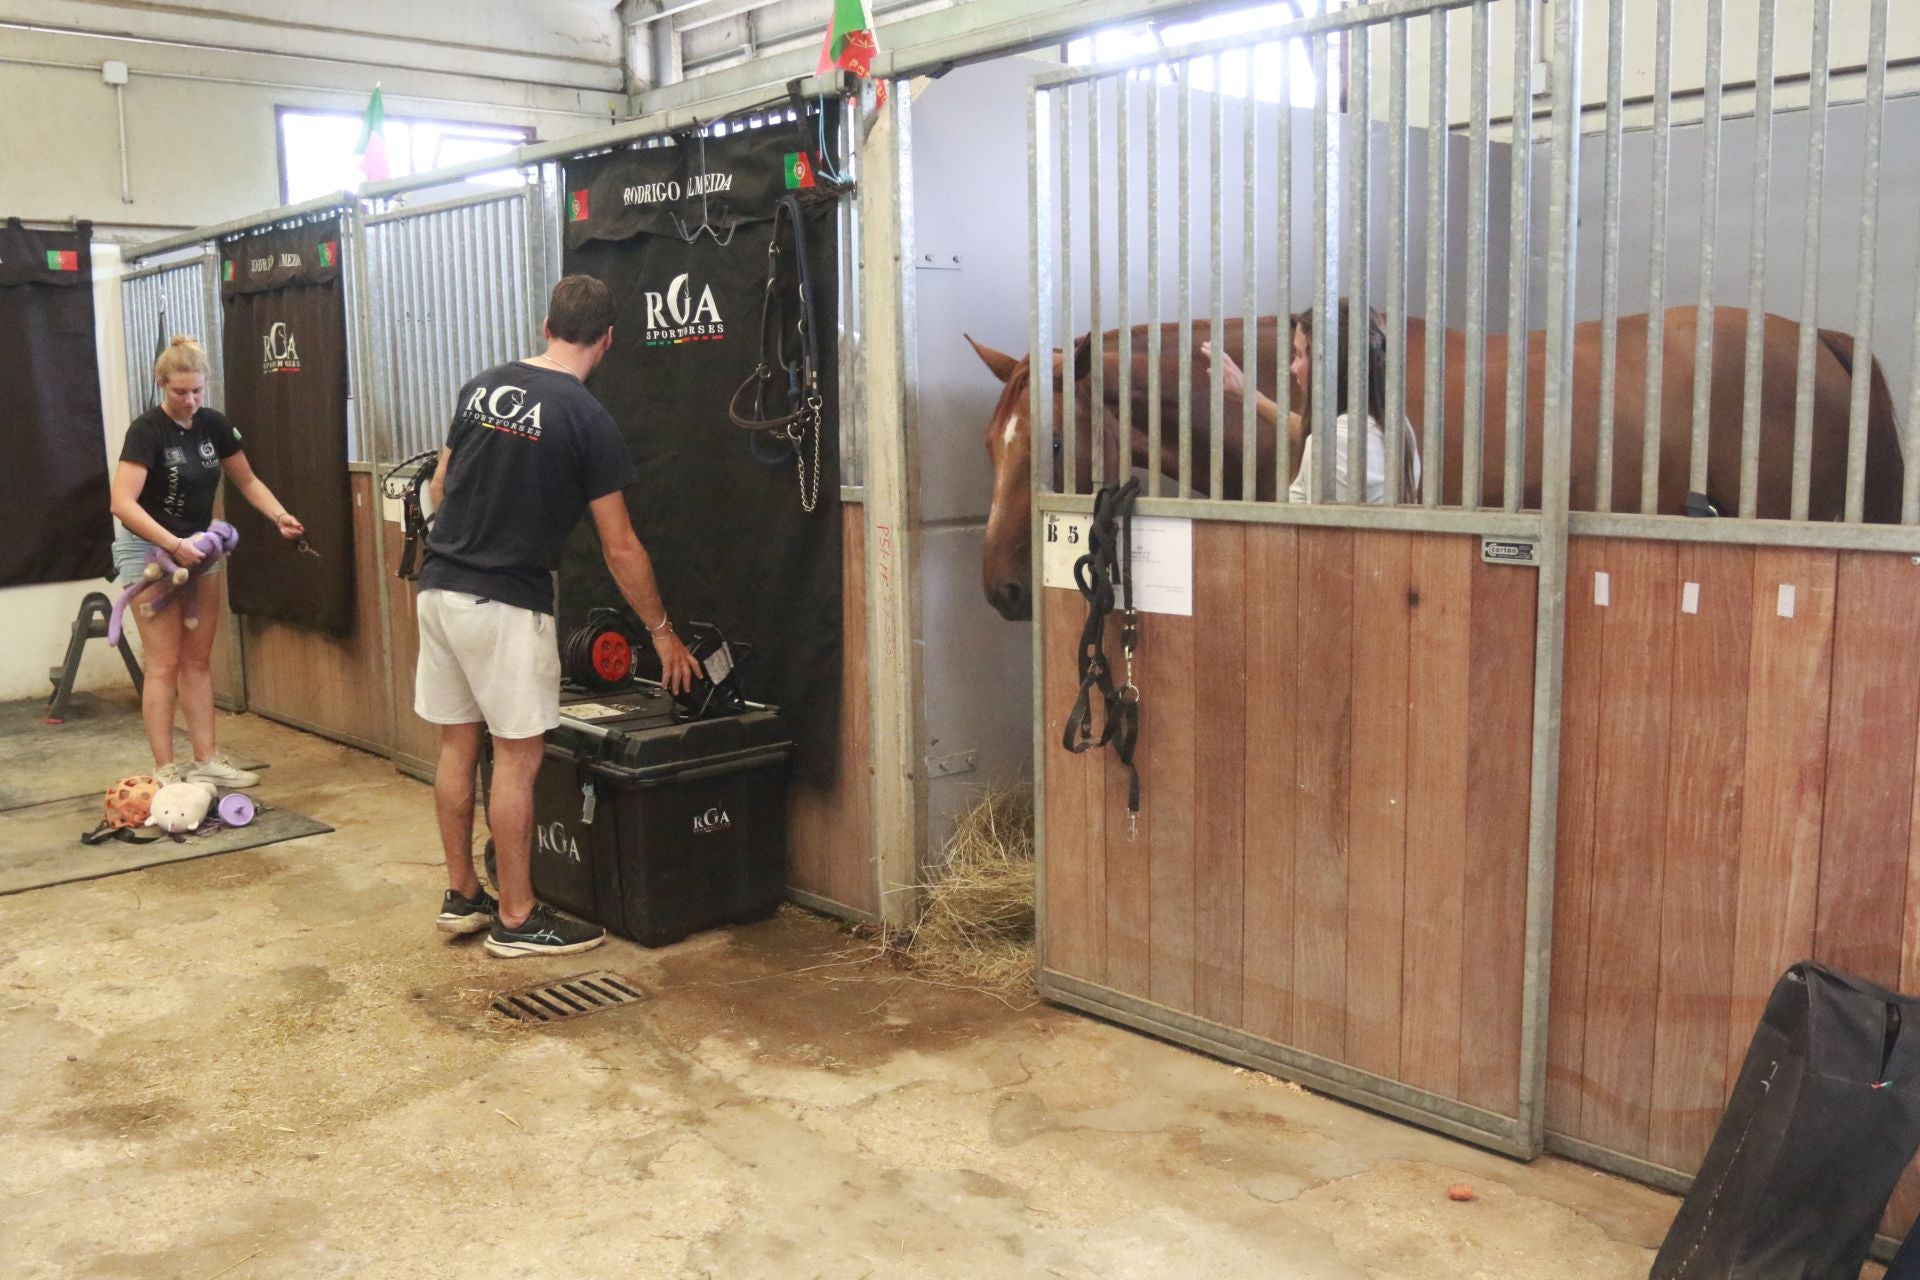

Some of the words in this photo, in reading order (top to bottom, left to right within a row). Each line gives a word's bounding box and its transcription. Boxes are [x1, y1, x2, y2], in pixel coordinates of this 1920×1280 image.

[624, 182, 681, 206] RODRIGO
[644, 272, 723, 330] RGA
[262, 322, 299, 362] RGA
[646, 324, 724, 340] SPORTORSES
[465, 385, 542, 430] RGA
[1048, 524, 1057, 542] B
[1068, 526, 1079, 544] 5
[693, 808, 730, 829] RGA
[537, 822, 581, 862] RGA
